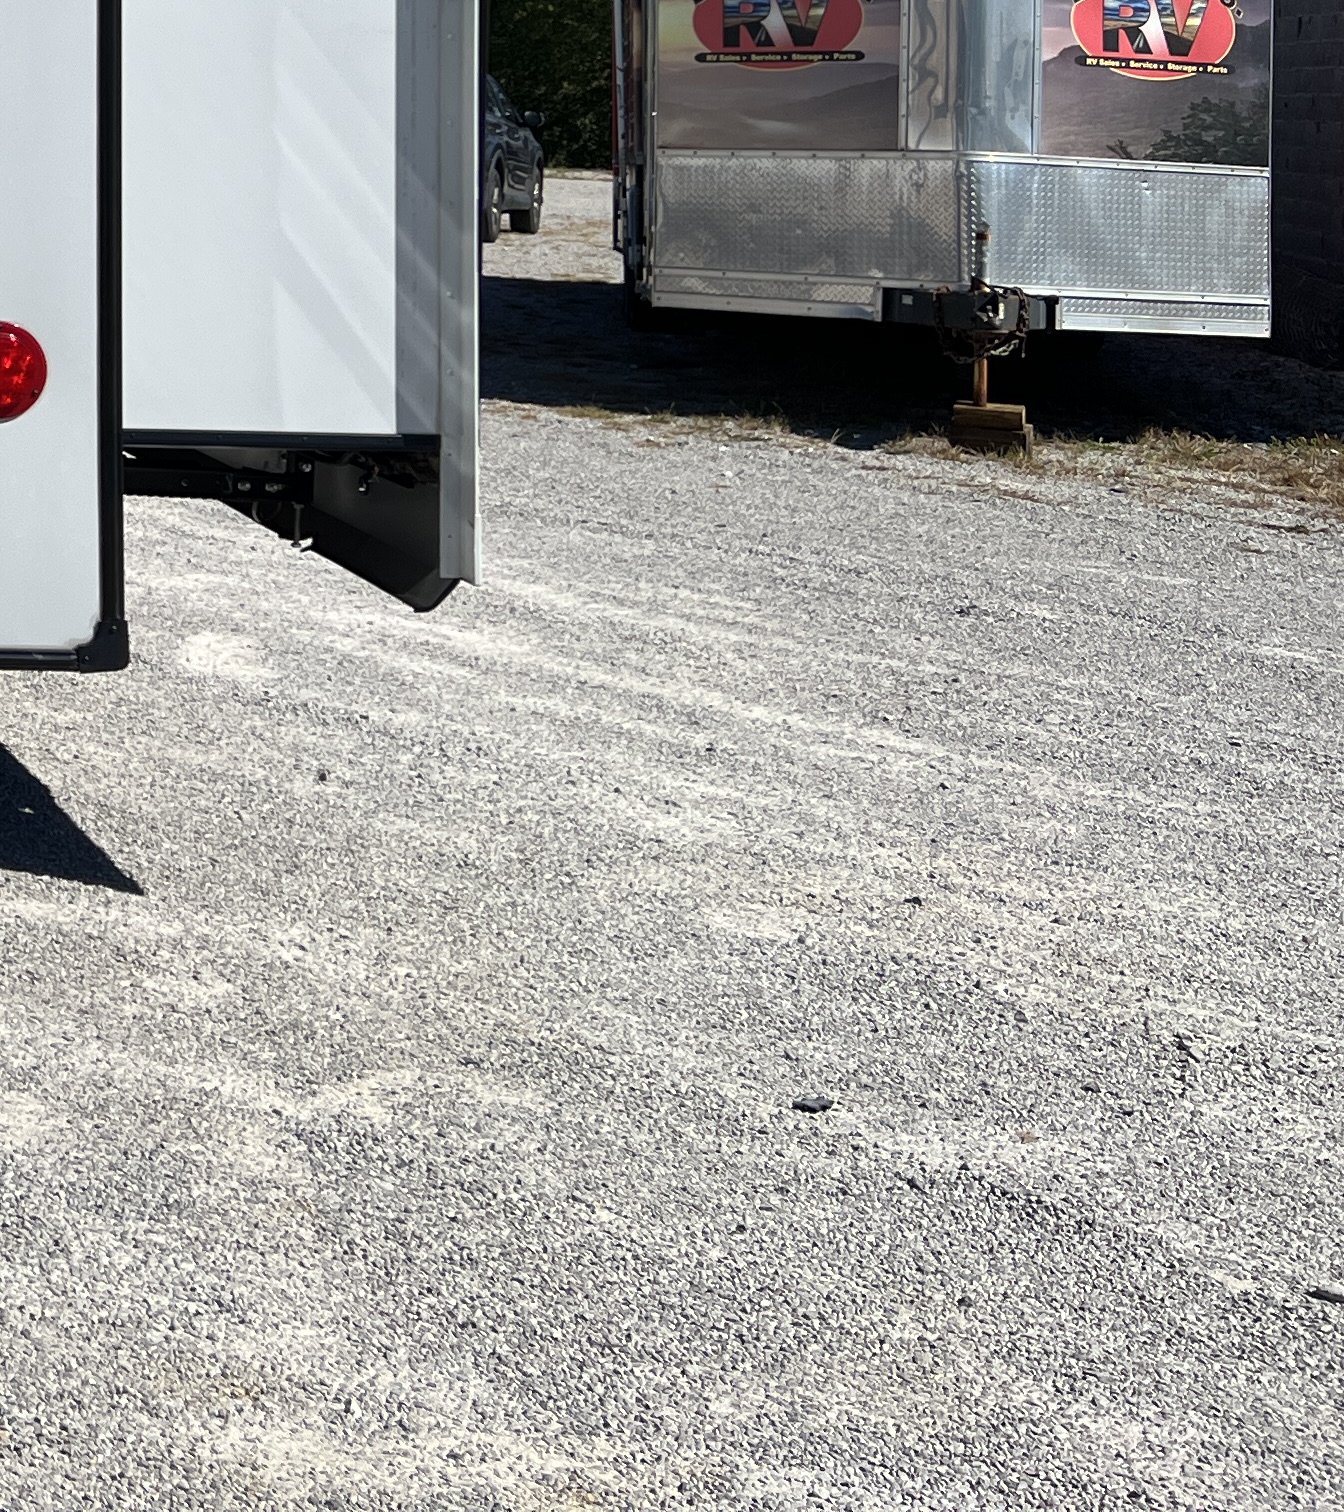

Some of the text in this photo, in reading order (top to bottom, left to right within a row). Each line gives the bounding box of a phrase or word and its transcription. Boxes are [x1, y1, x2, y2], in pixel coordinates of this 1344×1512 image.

[706, 52, 856, 63] RV Sales Service Storage Parts
[1086, 57, 1228, 74] RV Sales Service Storage Parts
